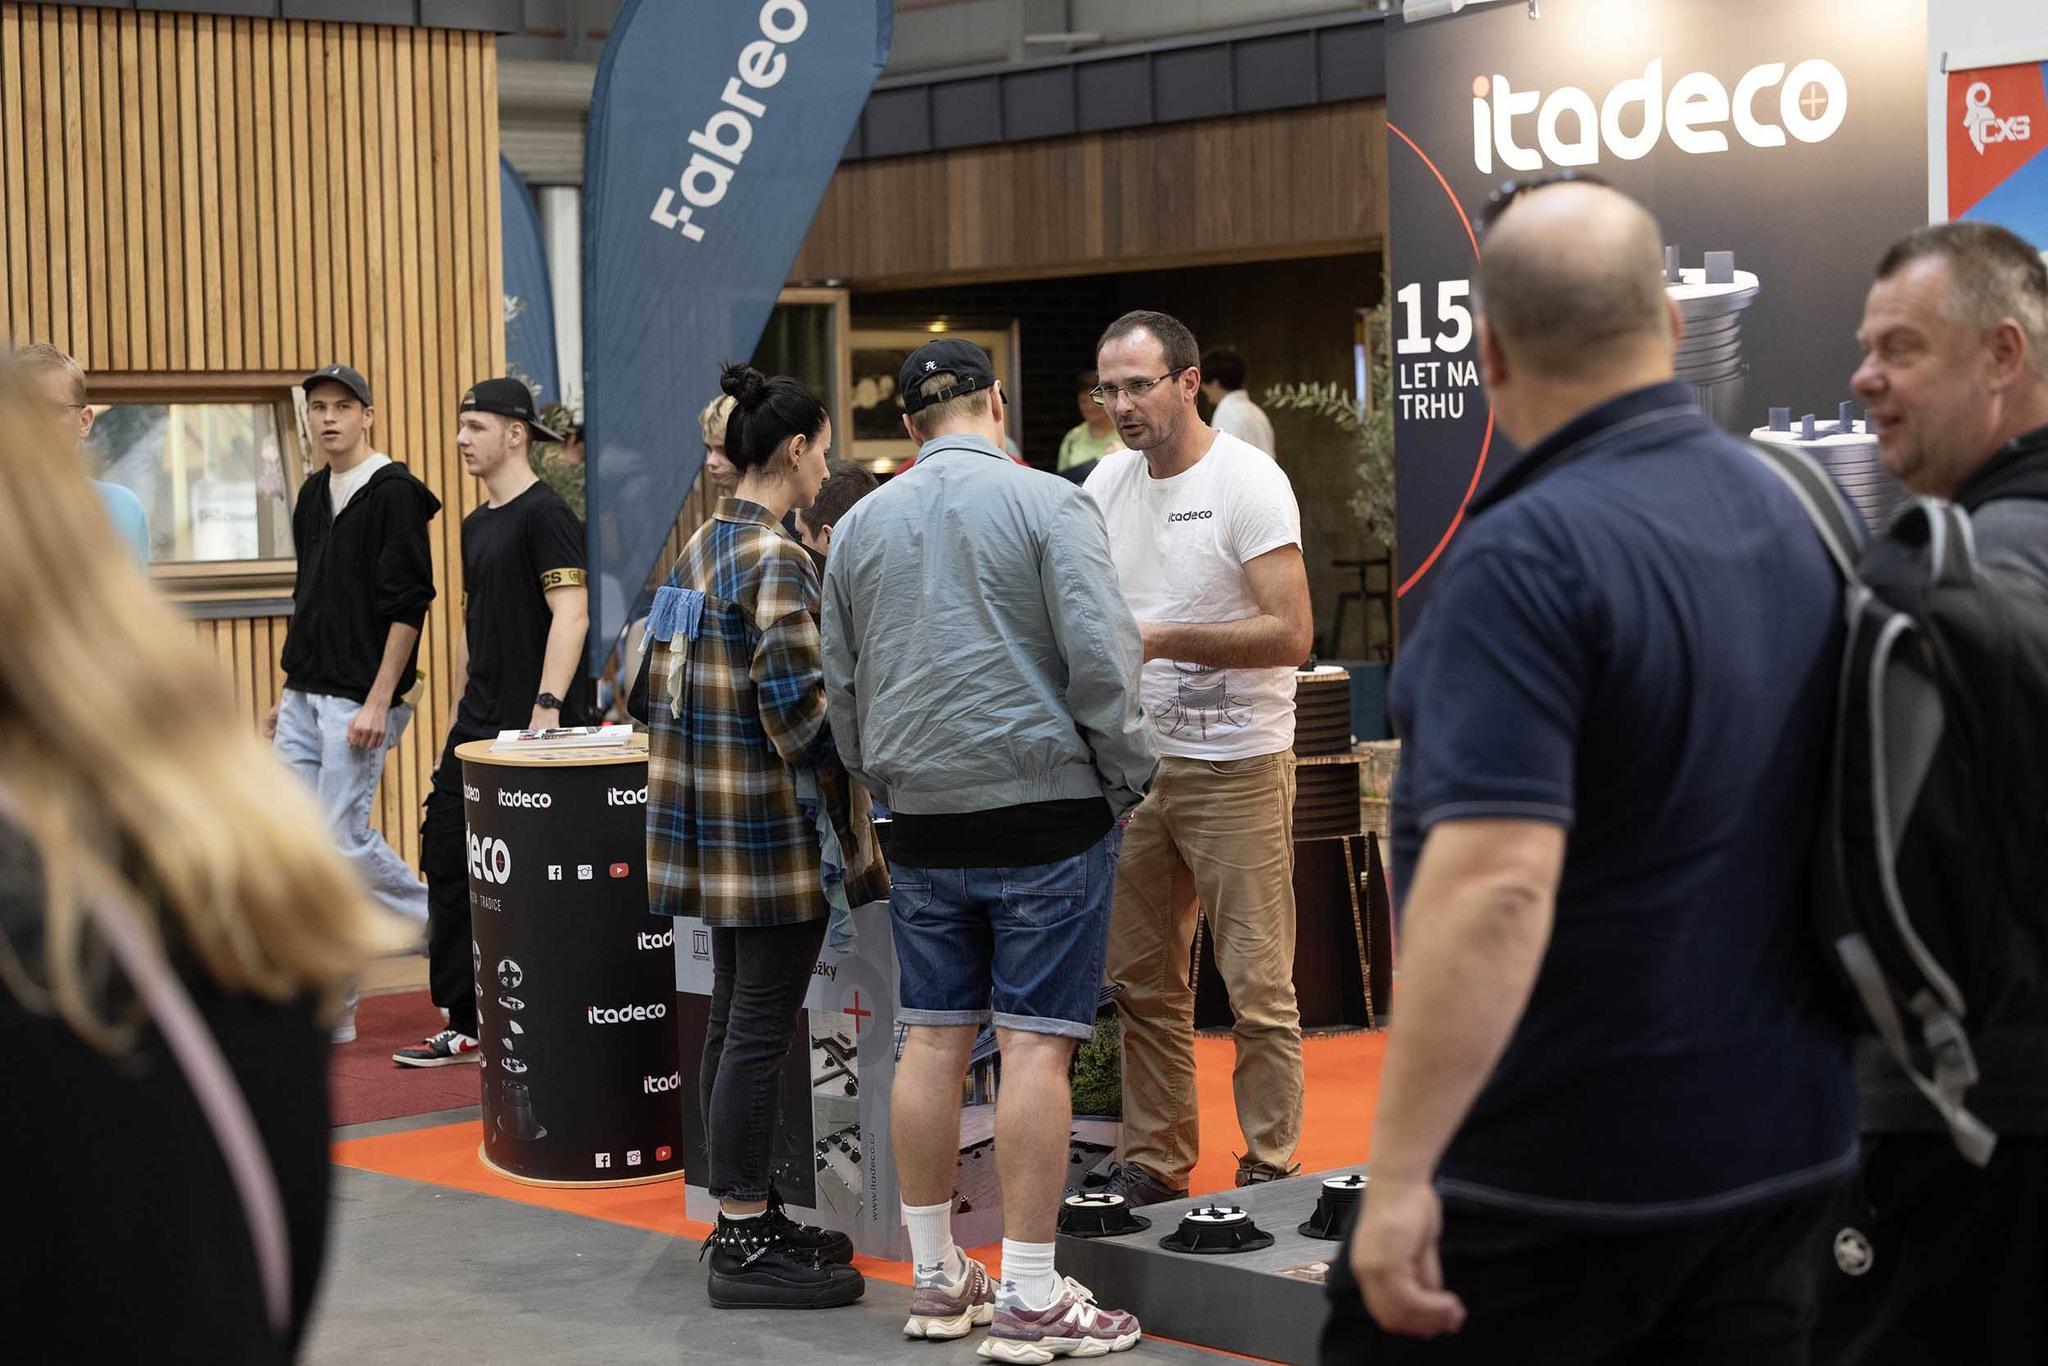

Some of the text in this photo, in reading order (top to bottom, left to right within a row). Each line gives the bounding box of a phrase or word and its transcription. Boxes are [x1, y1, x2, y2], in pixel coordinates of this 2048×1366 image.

[650, 0, 808, 242] Fabreo
[1472, 57, 1848, 174] itadeco
[1980, 115, 2031, 143] CXS
[1397, 279, 1473, 354] 15
[1400, 360, 1479, 389] LET NA
[1399, 392, 1464, 420] TRHU
[1168, 510, 1212, 522] itadeco
[498, 787, 552, 808] itadeco
[608, 785, 648, 806] itad
[637, 928, 674, 950] itad
[587, 1003, 667, 1025] itadeco
[643, 1071, 681, 1094] itad
[869, 1132, 878, 1222] www.itadeco.cz
